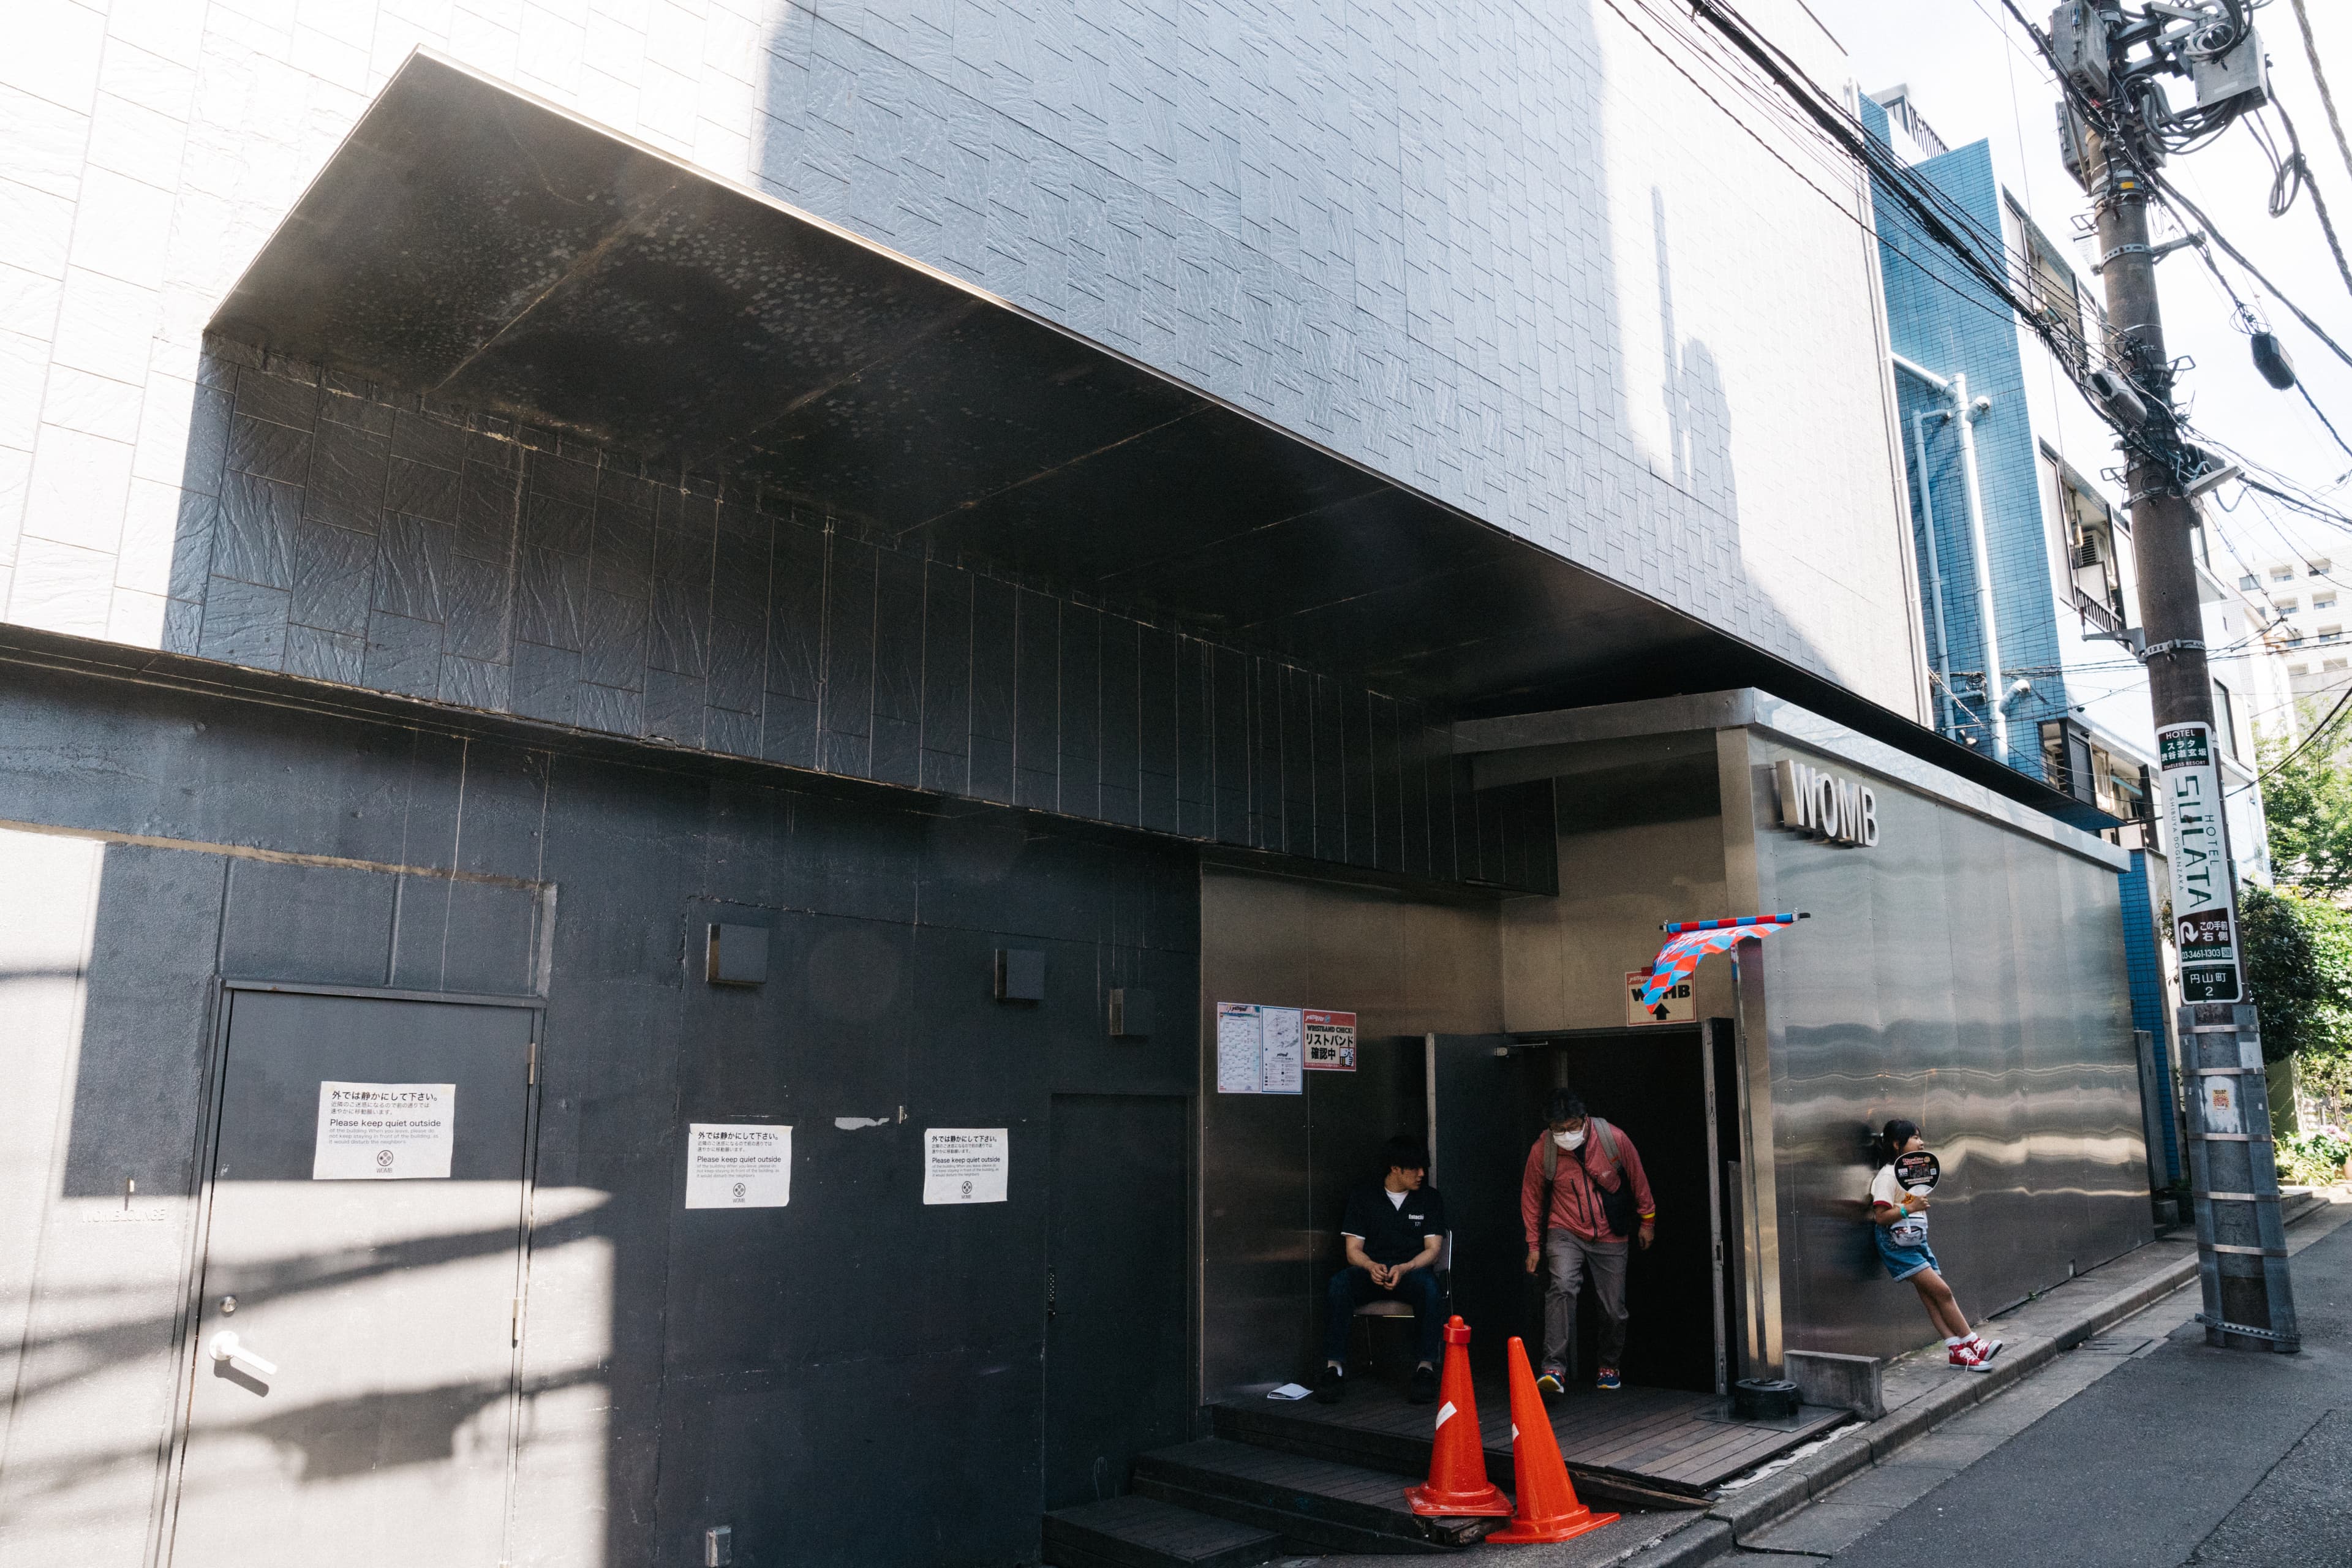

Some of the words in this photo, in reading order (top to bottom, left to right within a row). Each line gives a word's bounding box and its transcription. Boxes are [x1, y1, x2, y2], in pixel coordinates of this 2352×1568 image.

[2166, 729, 2195, 740] HOTEL
[2167, 739, 2196, 751] スラタ
[2161, 748, 2207, 762] 渋谷道玄坂
[2164, 761, 2185, 770] TIMELESS
[1782, 760, 1879, 846] WOMB
[2169, 797, 2177, 833] SHIBUYA
[2174, 837, 2184, 891] DOGENZAKA
[2176, 775, 2212, 908] SULATA
[2205, 815, 2220, 866] HOTEL
[2199, 921, 2228, 931] この手前
[2202, 932, 2228, 942] 右側
[2181, 948, 2222, 959] 03-3461-1303
[2190, 972, 2226, 984] 円山町
[1631, 984, 1691, 1002] WMB
[2205, 986, 2214, 996] 2
[1306, 1033, 1354, 1047] リストバンド
[1311, 1047, 1336, 1060] 確認中
[331, 1090, 438, 1102] 外では静かにして下さい。
[361, 1120, 383, 1128] keep
[385, 1120, 407, 1128] quiet
[698, 1132, 778, 1140] 外では静かにして下さい。
